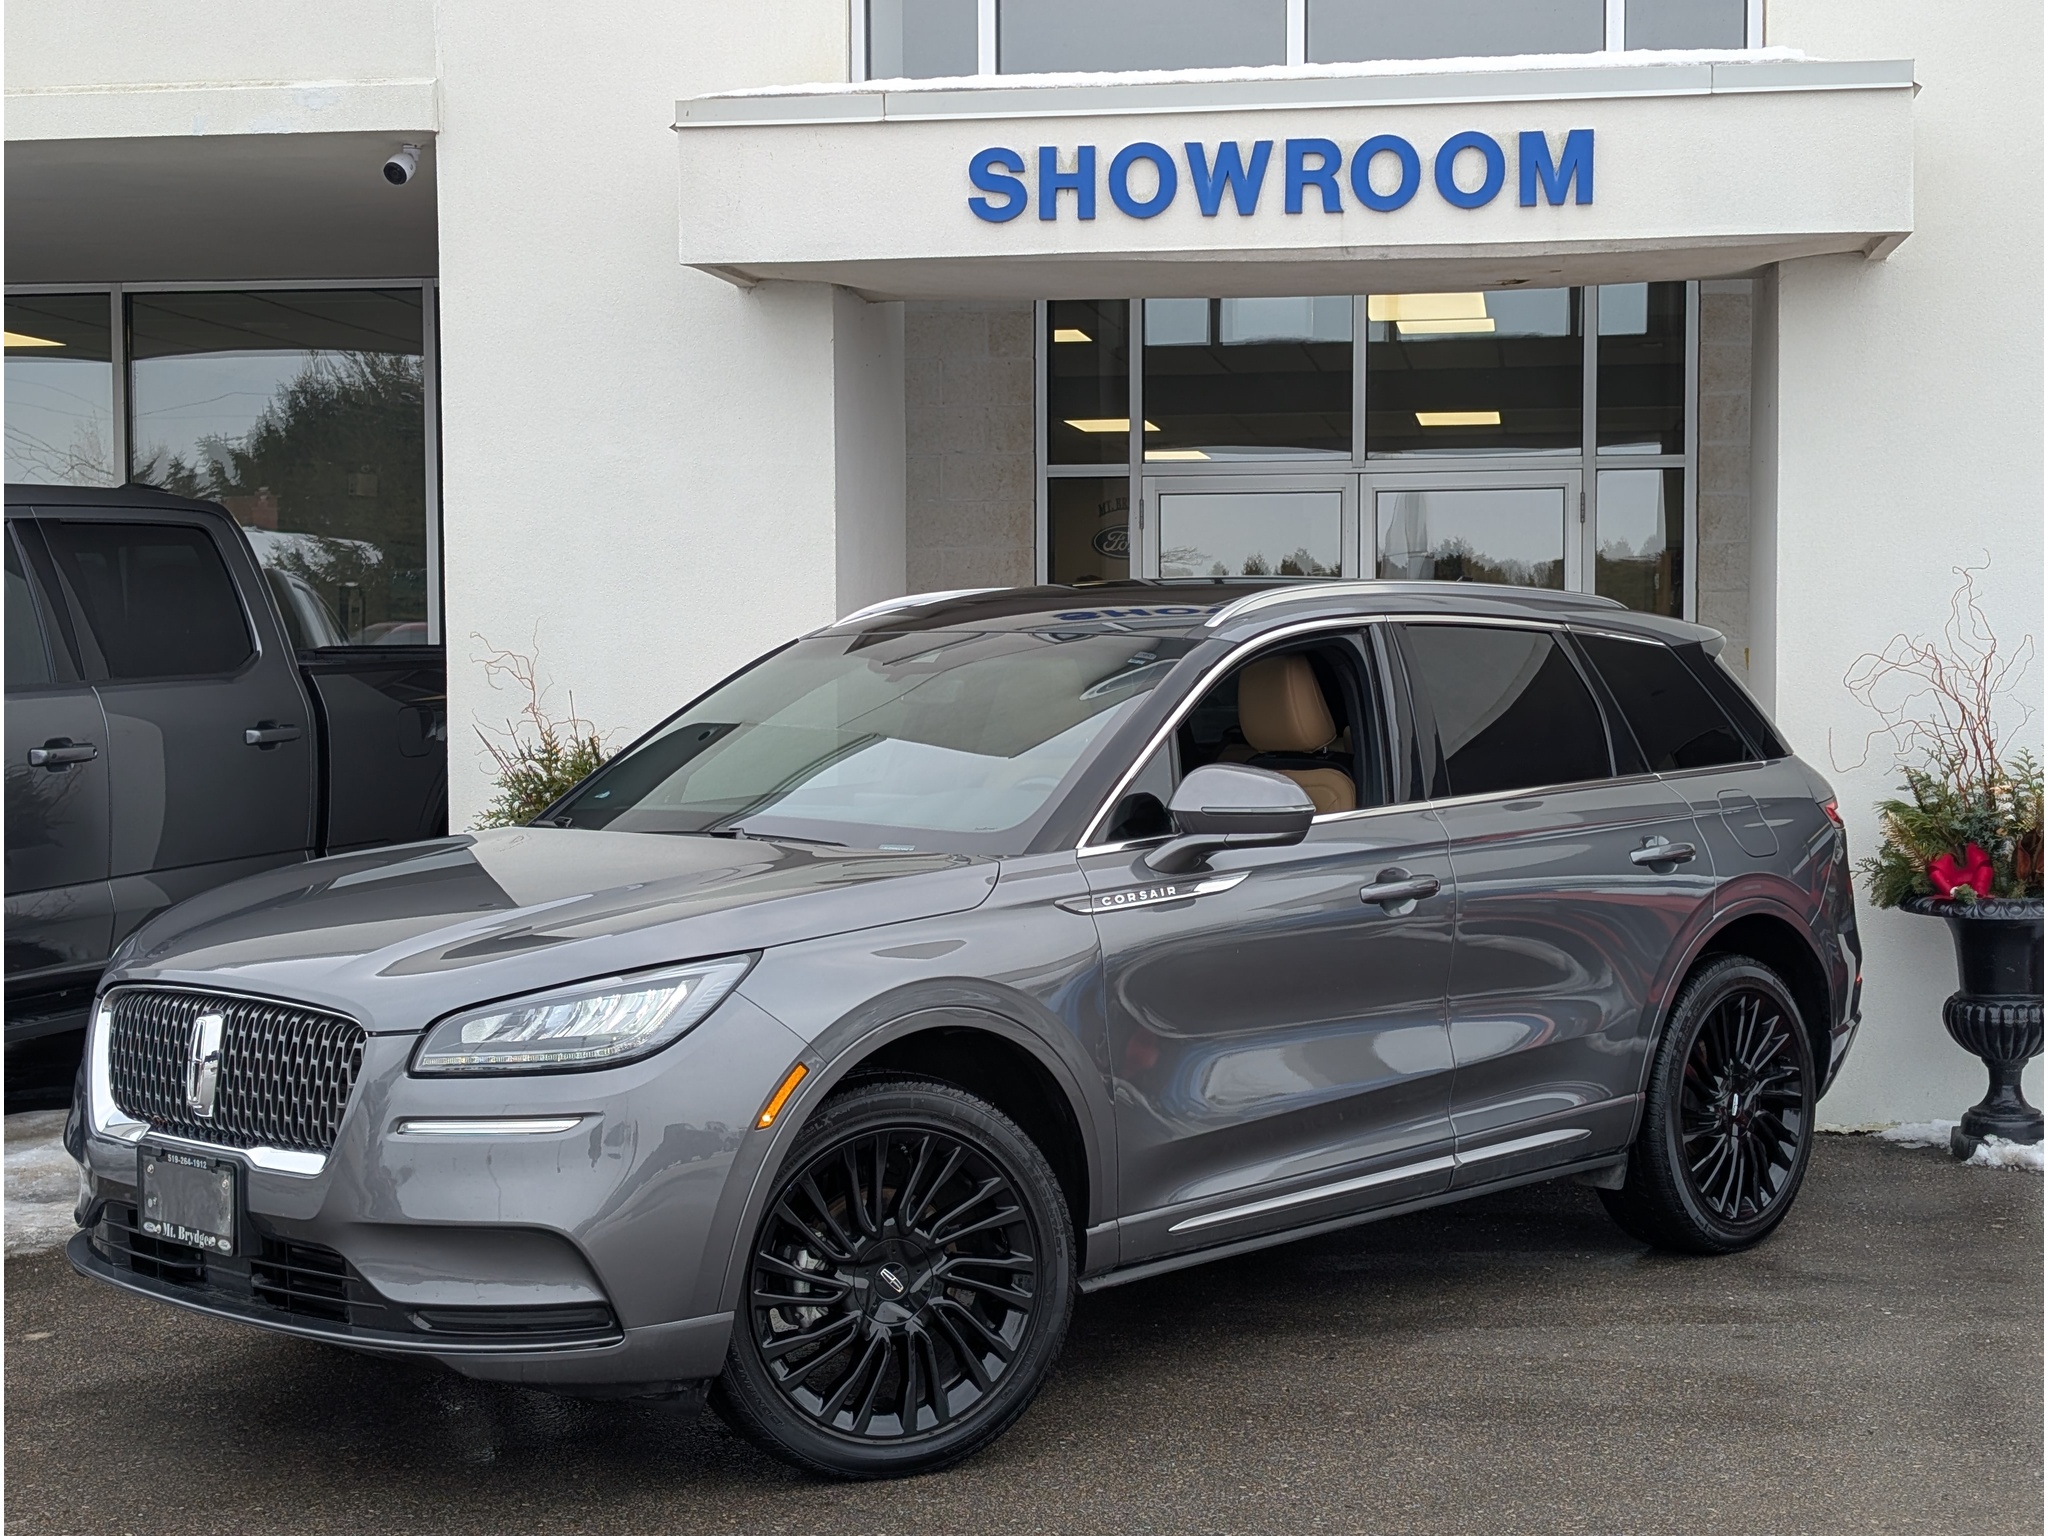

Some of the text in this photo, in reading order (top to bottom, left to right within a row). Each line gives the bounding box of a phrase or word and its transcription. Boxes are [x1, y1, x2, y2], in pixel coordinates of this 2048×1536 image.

[968, 129, 1594, 222] SHOWROOM
[1101, 886, 1177, 907] CORSAIR
[167, 1153, 208, 1170] 519-264-1912
[162, 1222, 176, 1239] Mt.
